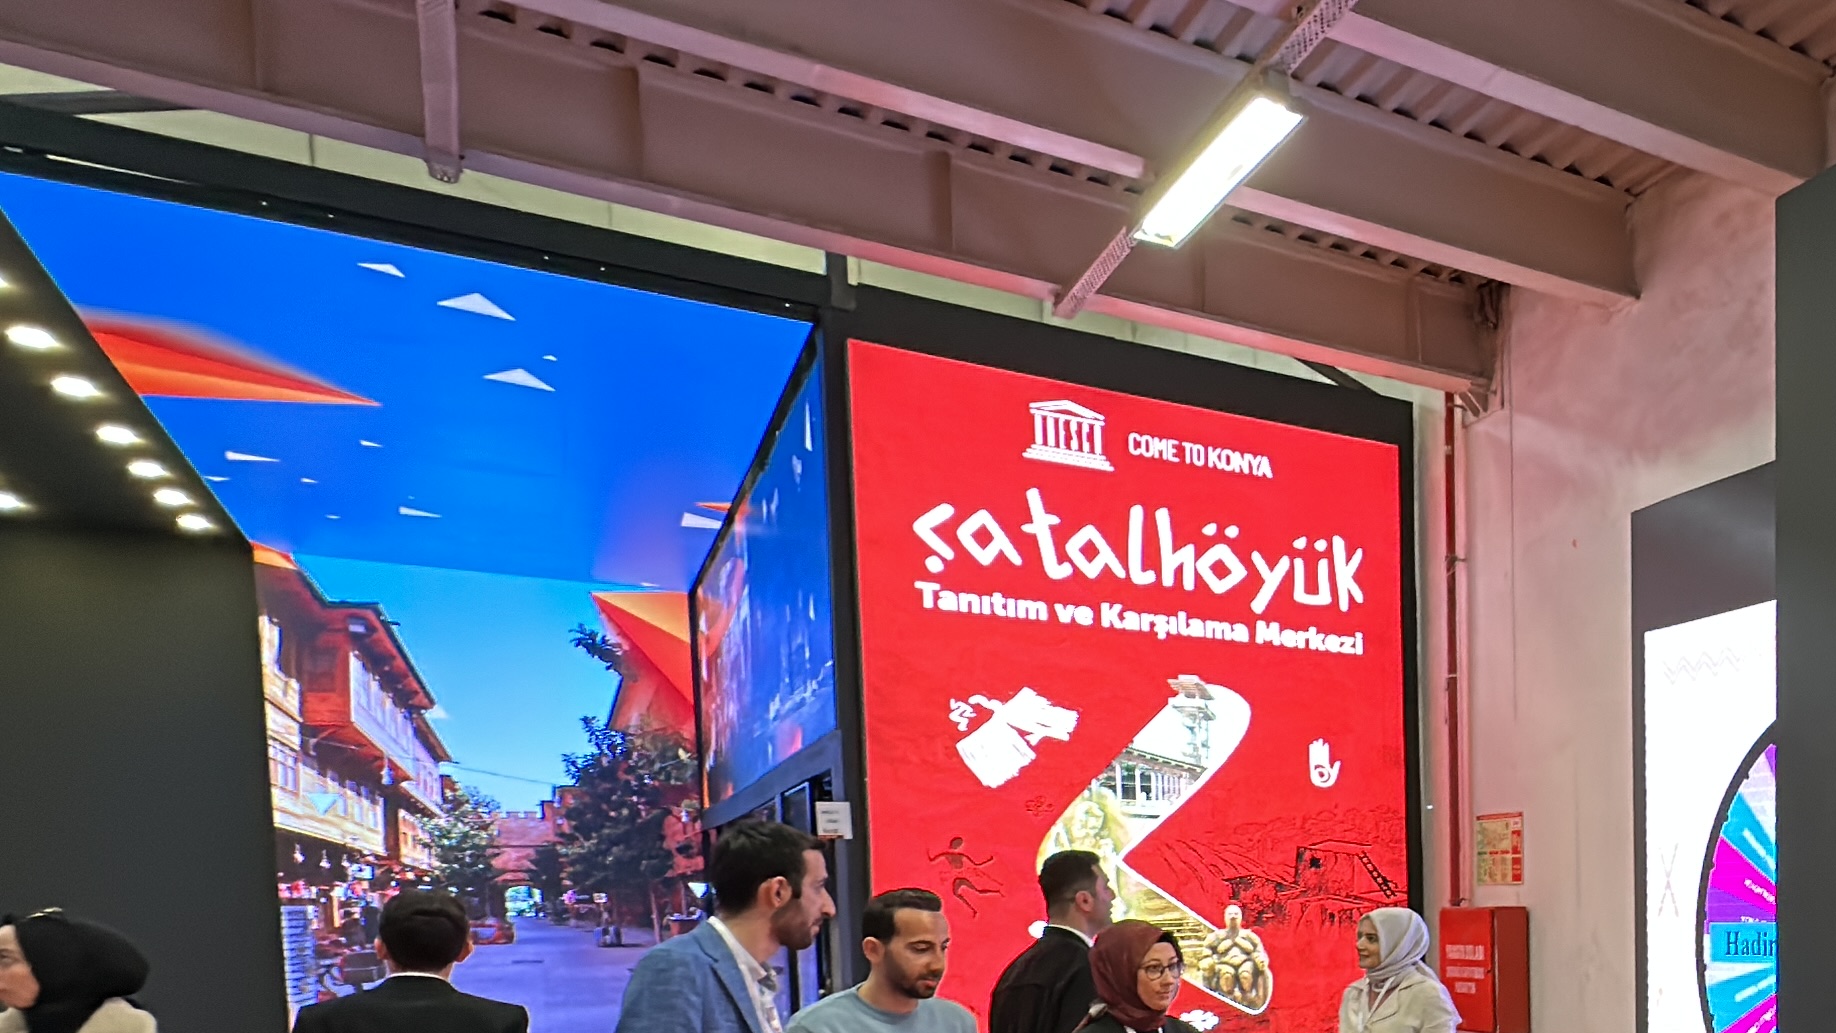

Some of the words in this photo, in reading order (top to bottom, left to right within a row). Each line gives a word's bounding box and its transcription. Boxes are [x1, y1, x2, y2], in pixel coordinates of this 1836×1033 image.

[1127, 432, 1180, 463] COME
[1181, 441, 1205, 467] TO
[1206, 446, 1274, 479] KONYA
[913, 580, 1049, 622] Tanıtım
[1053, 603, 1094, 627] ve
[1100, 602, 1250, 640] Karşılama
[1254, 619, 1364, 656] Merkezi
